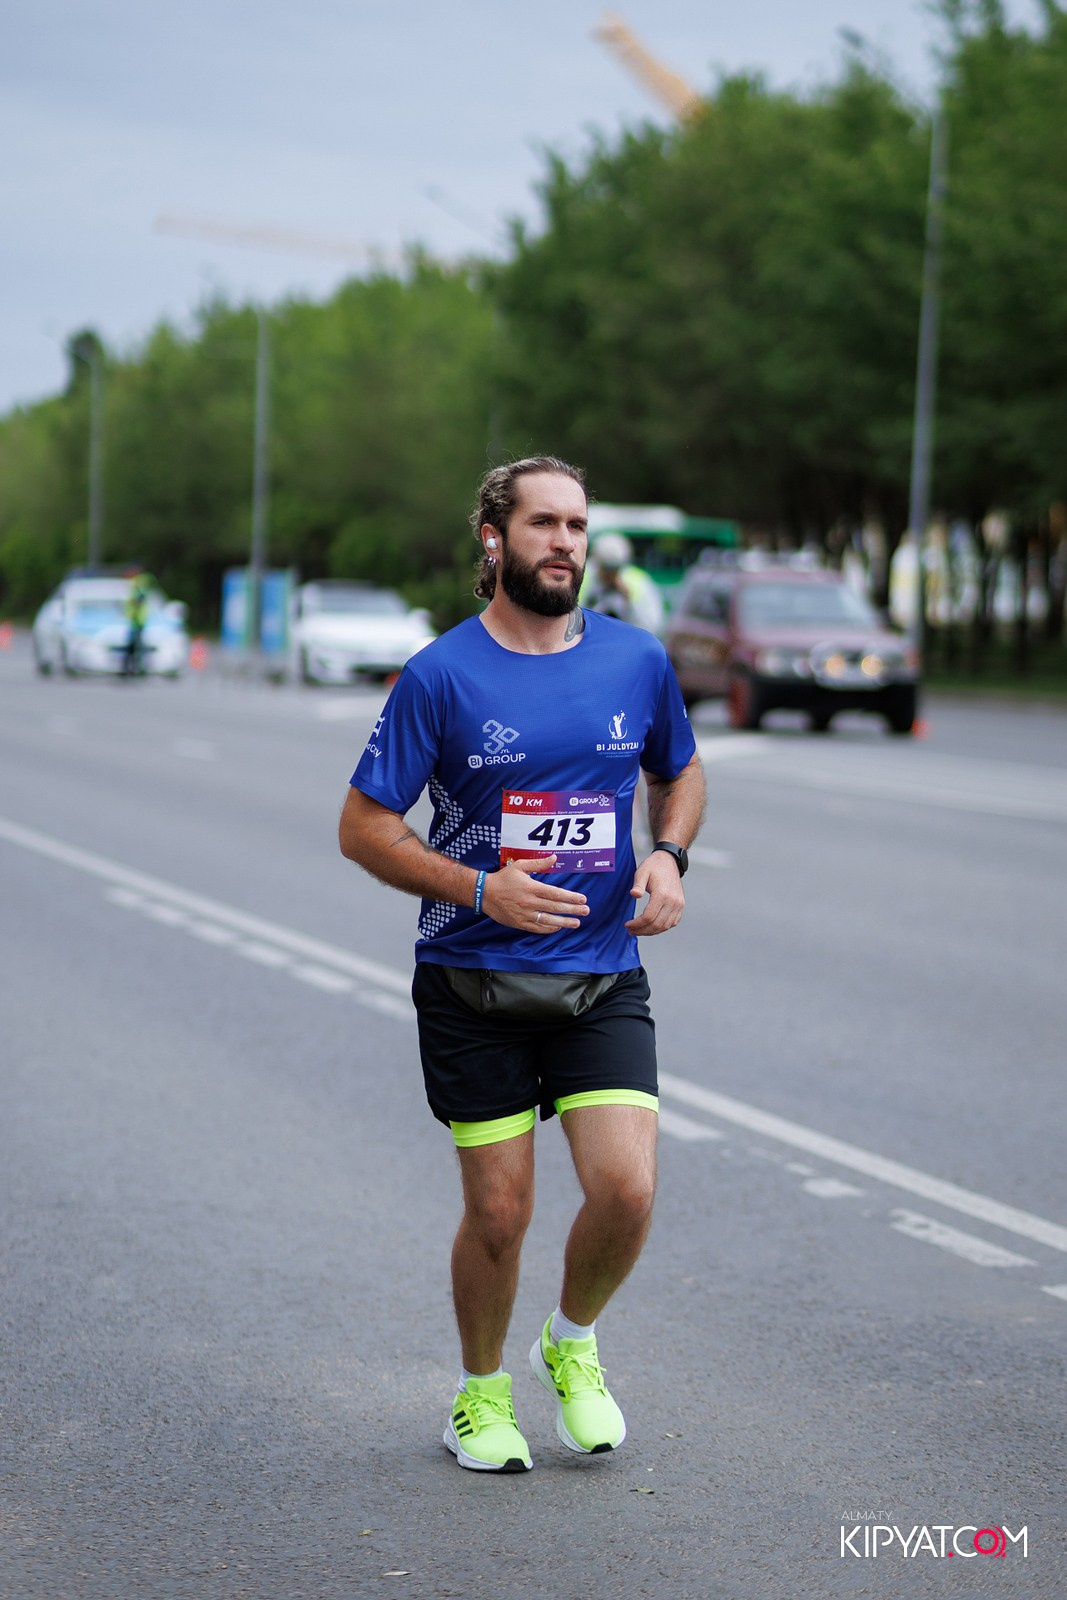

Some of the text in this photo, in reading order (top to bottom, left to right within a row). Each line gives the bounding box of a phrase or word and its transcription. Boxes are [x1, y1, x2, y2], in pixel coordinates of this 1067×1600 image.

[607, 742, 639, 751] JULDYZAI
[469, 753, 526, 767] BI GROUP
[508, 795, 543, 807] 10 KM
[527, 817, 595, 847] 413
